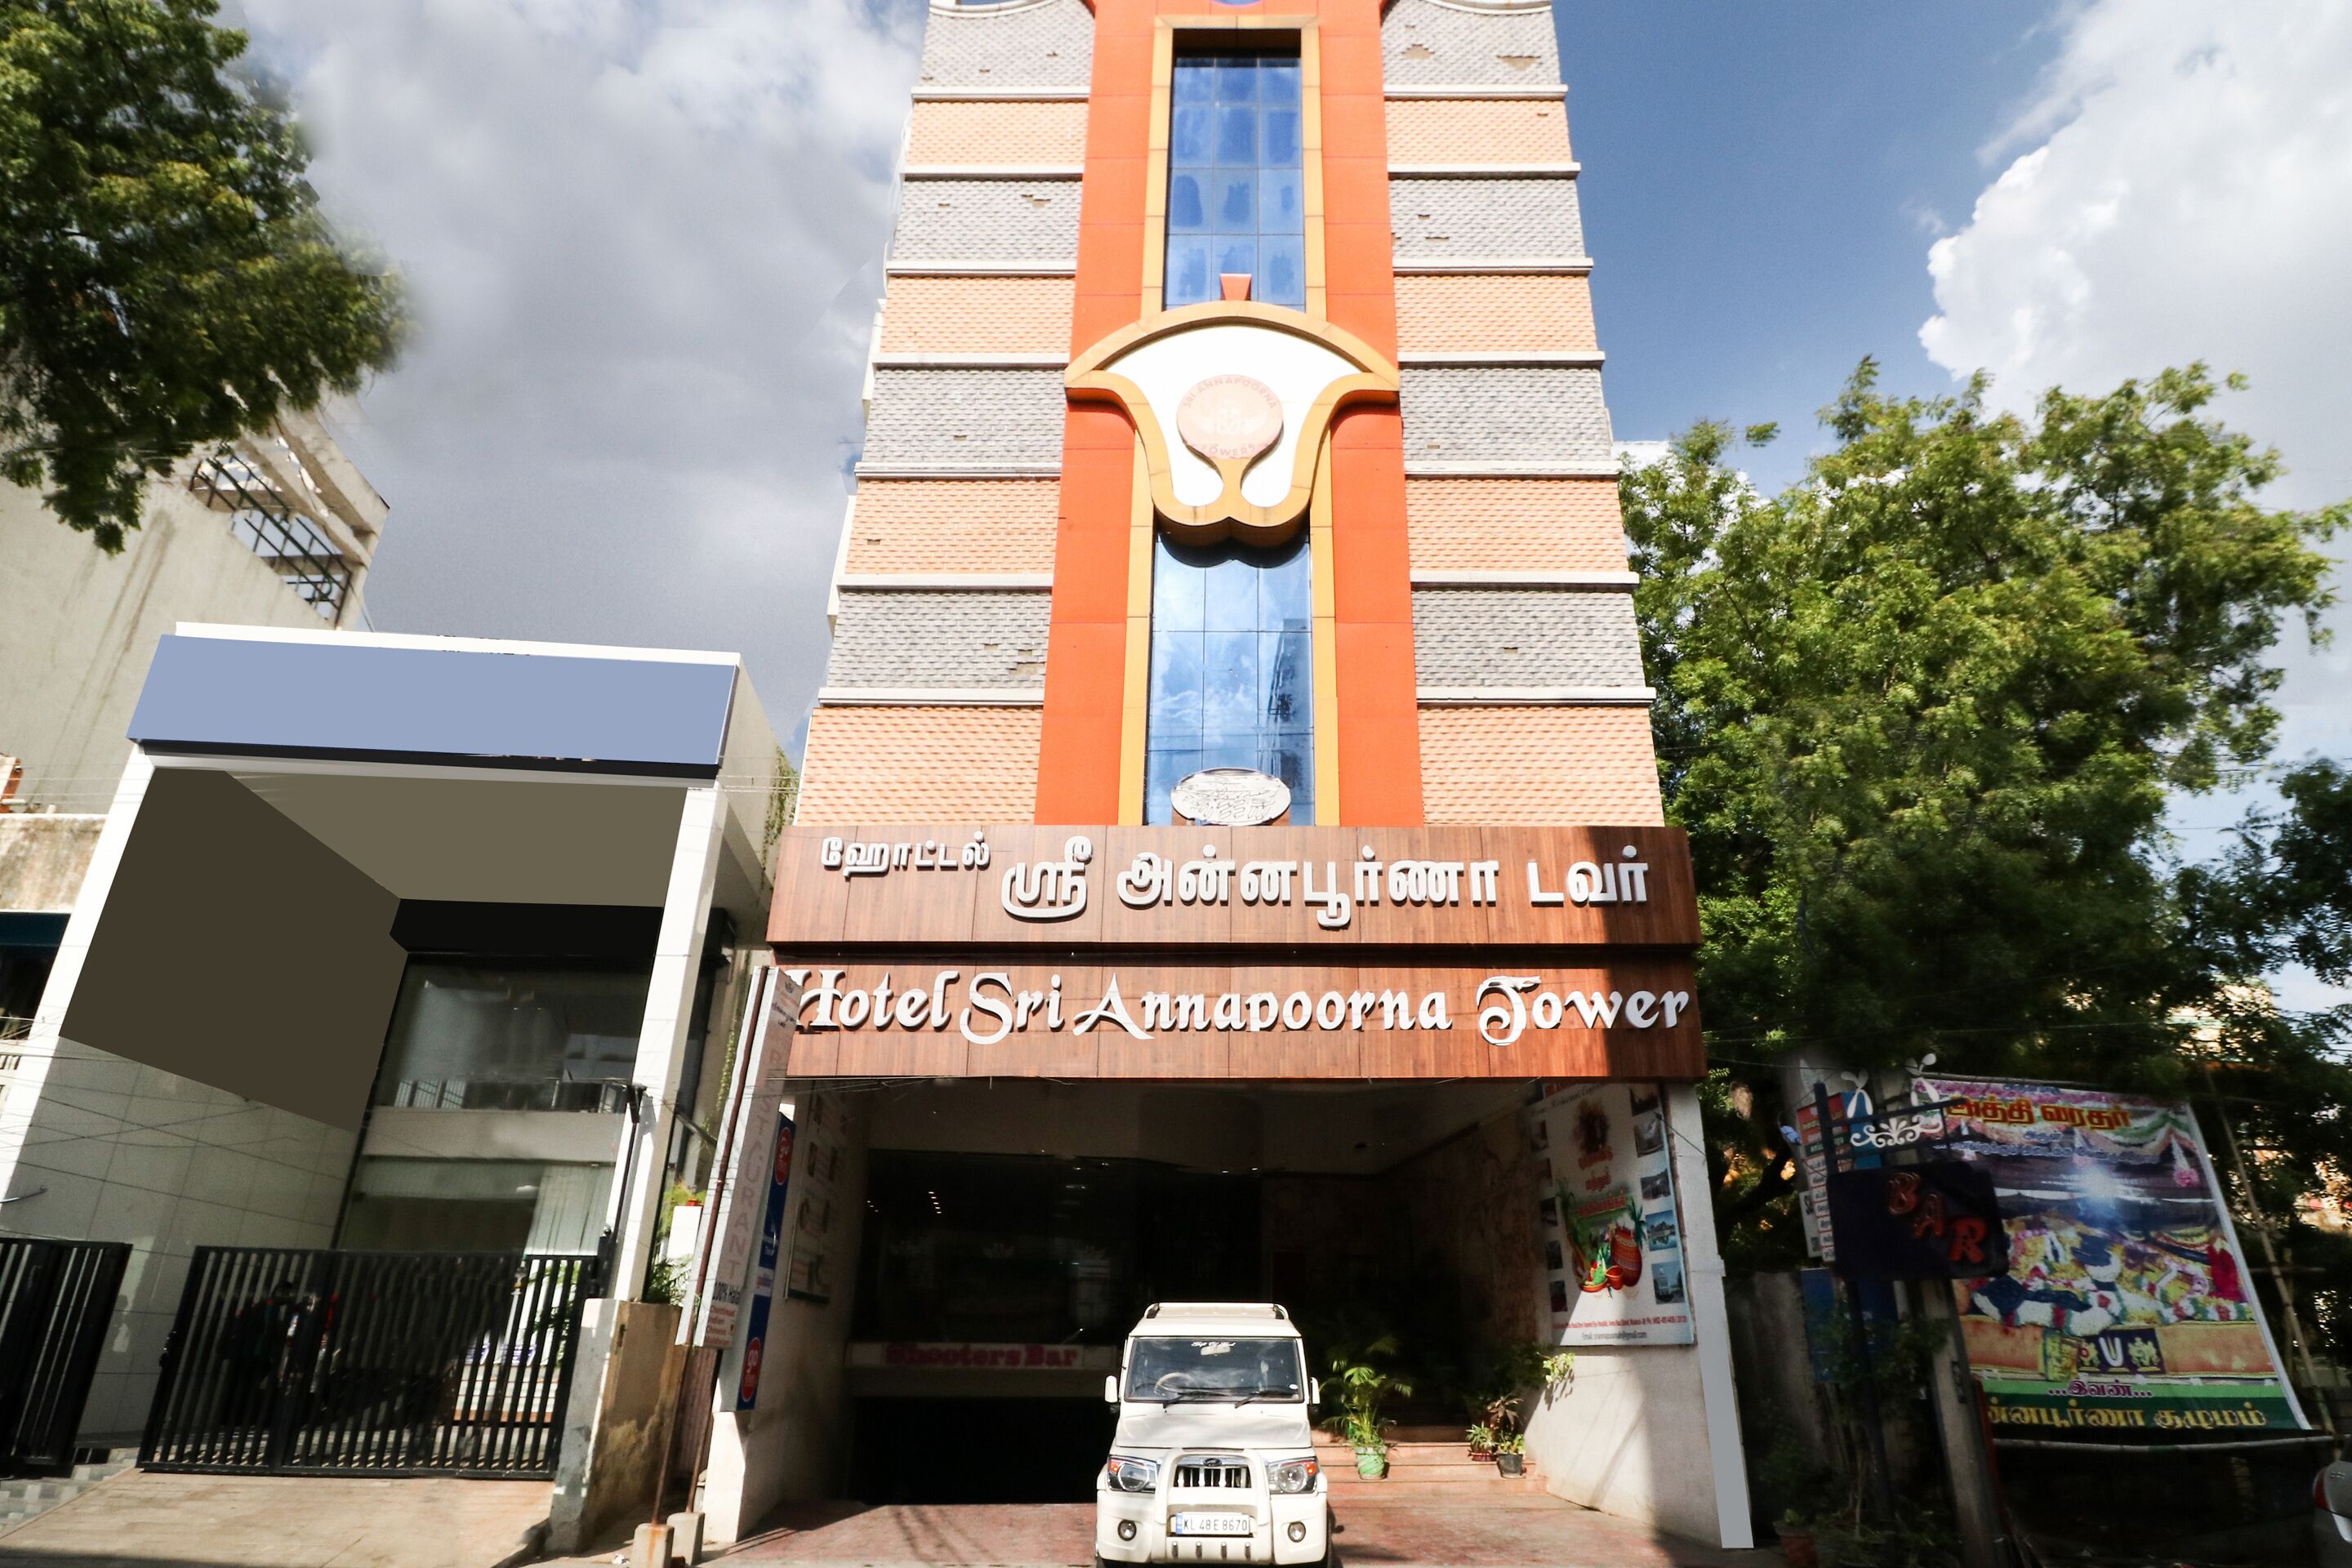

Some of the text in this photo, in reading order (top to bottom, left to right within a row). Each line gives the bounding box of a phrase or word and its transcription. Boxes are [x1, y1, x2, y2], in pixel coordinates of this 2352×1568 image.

[1198, 376, 1277, 408] ANNAPOORNA
[820, 831, 991, 878] ஹோட்டல்
[1116, 844, 1499, 929] அன்னபூர்ணா
[1527, 844, 1648, 905] டவர்
[786, 969, 1690, 1046] Hotel Sri Annapoorna Tower
[1887, 1171, 1988, 1263] BAR
[886, 1344, 1078, 1366] Shooters Bar
[1988, 1396, 2145, 1428] ன்னபூர்ணா
[1183, 1518, 1248, 1531] KL 48 E 8670
